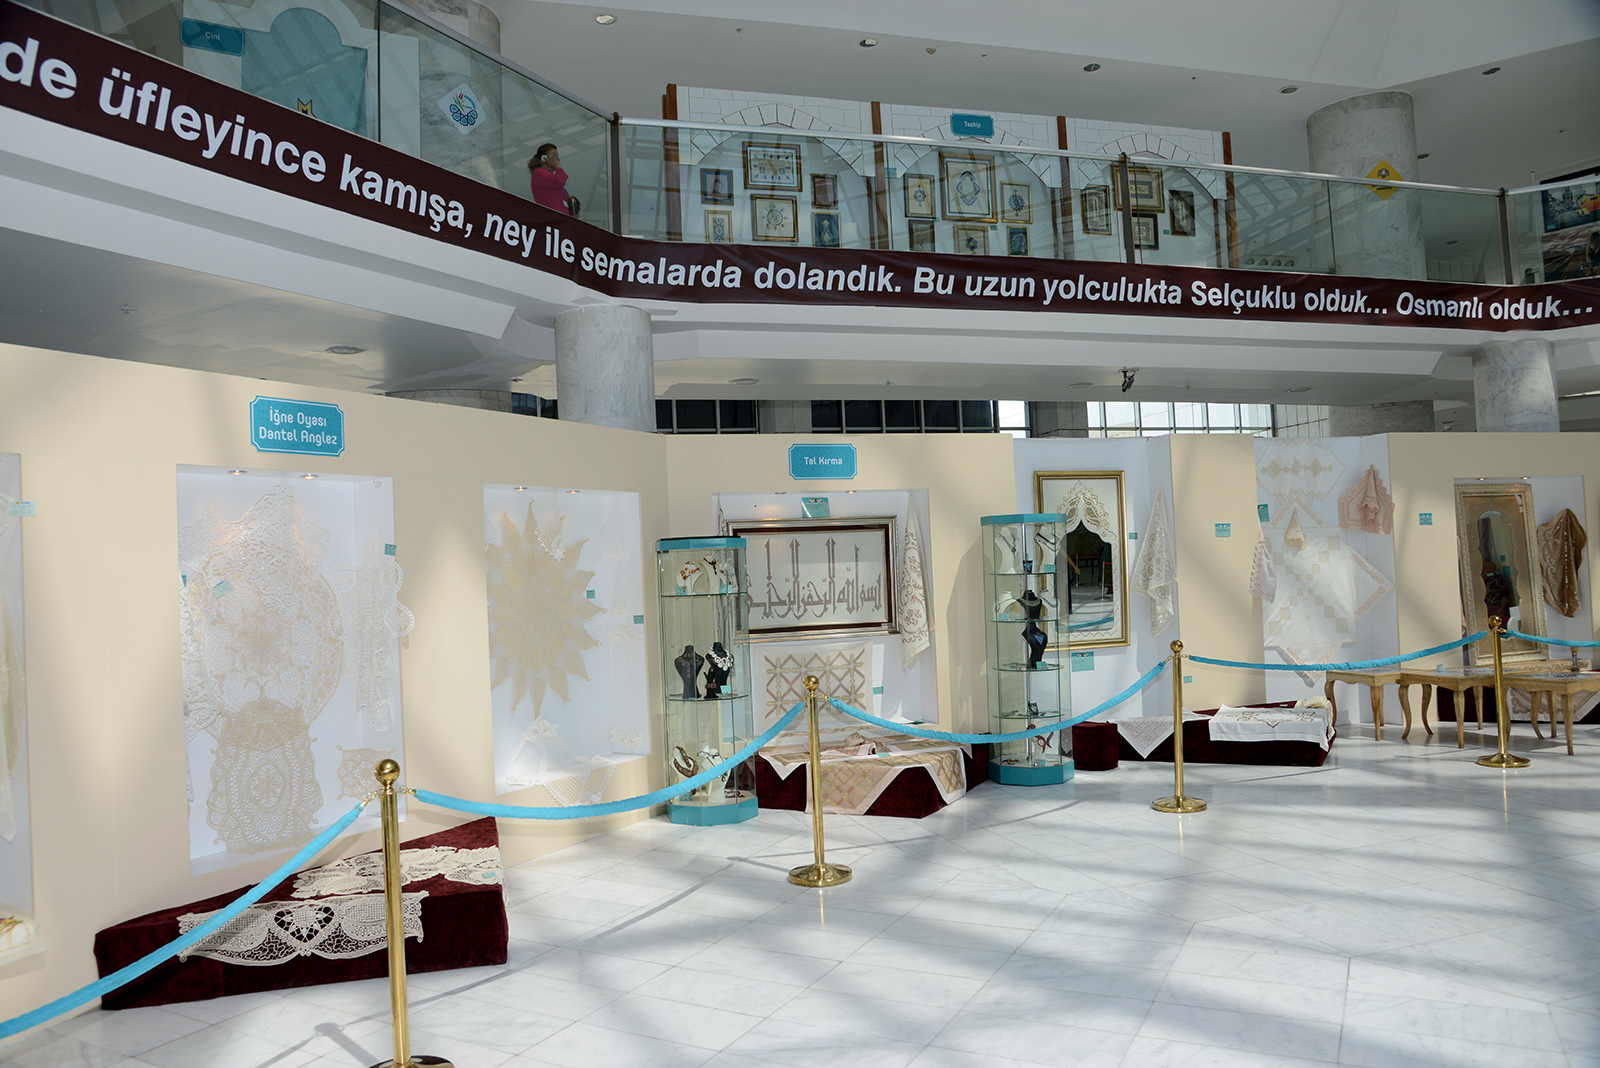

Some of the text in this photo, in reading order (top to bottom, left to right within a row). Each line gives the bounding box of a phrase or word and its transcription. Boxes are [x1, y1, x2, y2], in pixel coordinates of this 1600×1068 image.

[205, 31, 221, 41] Çini
[964, 121, 981, 129] Tezhip
[0, 38, 1593, 321] de üfleyince kamışa, ney ile semalarda dolandık. Bu uzun yolculukta Selçuklu olduk... Osmanlı olduk...
[269, 406, 327, 429] İğne Oyası
[259, 426, 338, 447] Dantel Anglez
[803, 456, 843, 465] Tel Kırma
